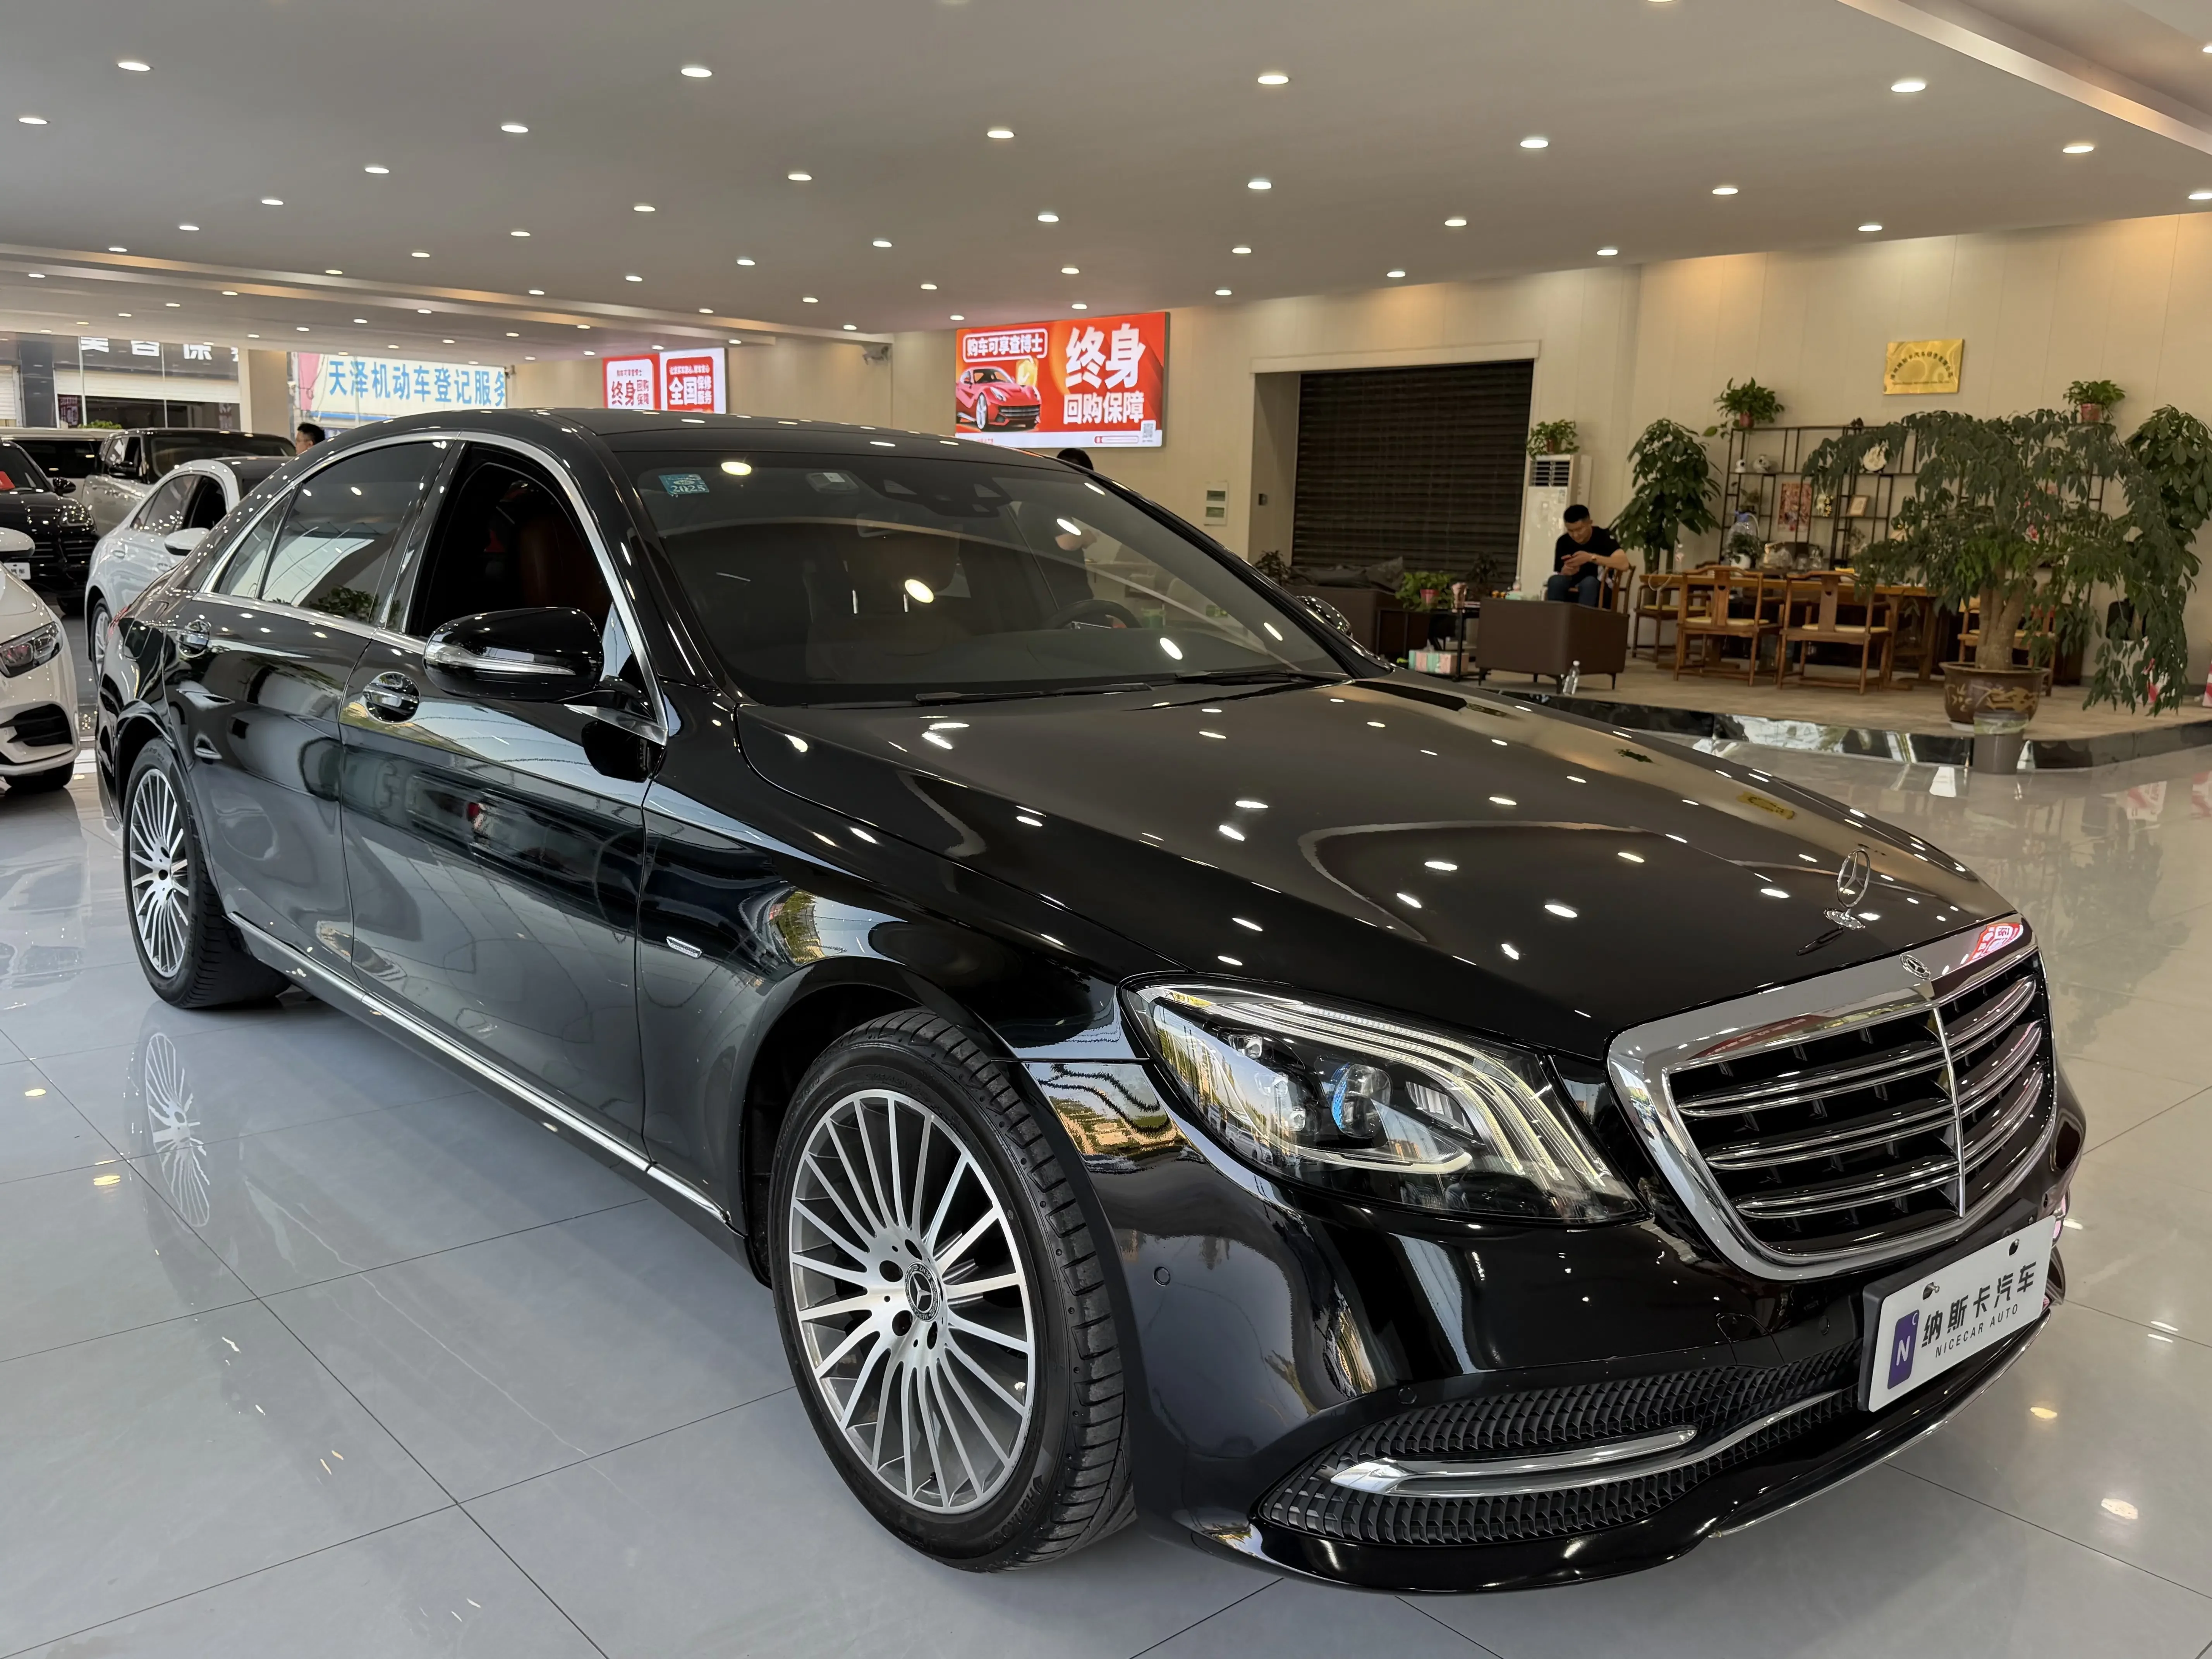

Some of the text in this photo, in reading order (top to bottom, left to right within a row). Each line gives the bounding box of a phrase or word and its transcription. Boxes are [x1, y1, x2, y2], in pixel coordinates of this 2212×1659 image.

[967, 336, 1043, 357] 购车可享查博士
[1065, 323, 1146, 389] 终身
[611, 380, 636, 406] 终身
[669, 377, 697, 405] 全国
[1063, 390, 1144, 425] 回购保障
[1921, 1261, 2037, 1348] 纳斯卡汽车
[1935, 1304, 2019, 1358] NICECAR AUTO
[1896, 1335, 1910, 1366] N
